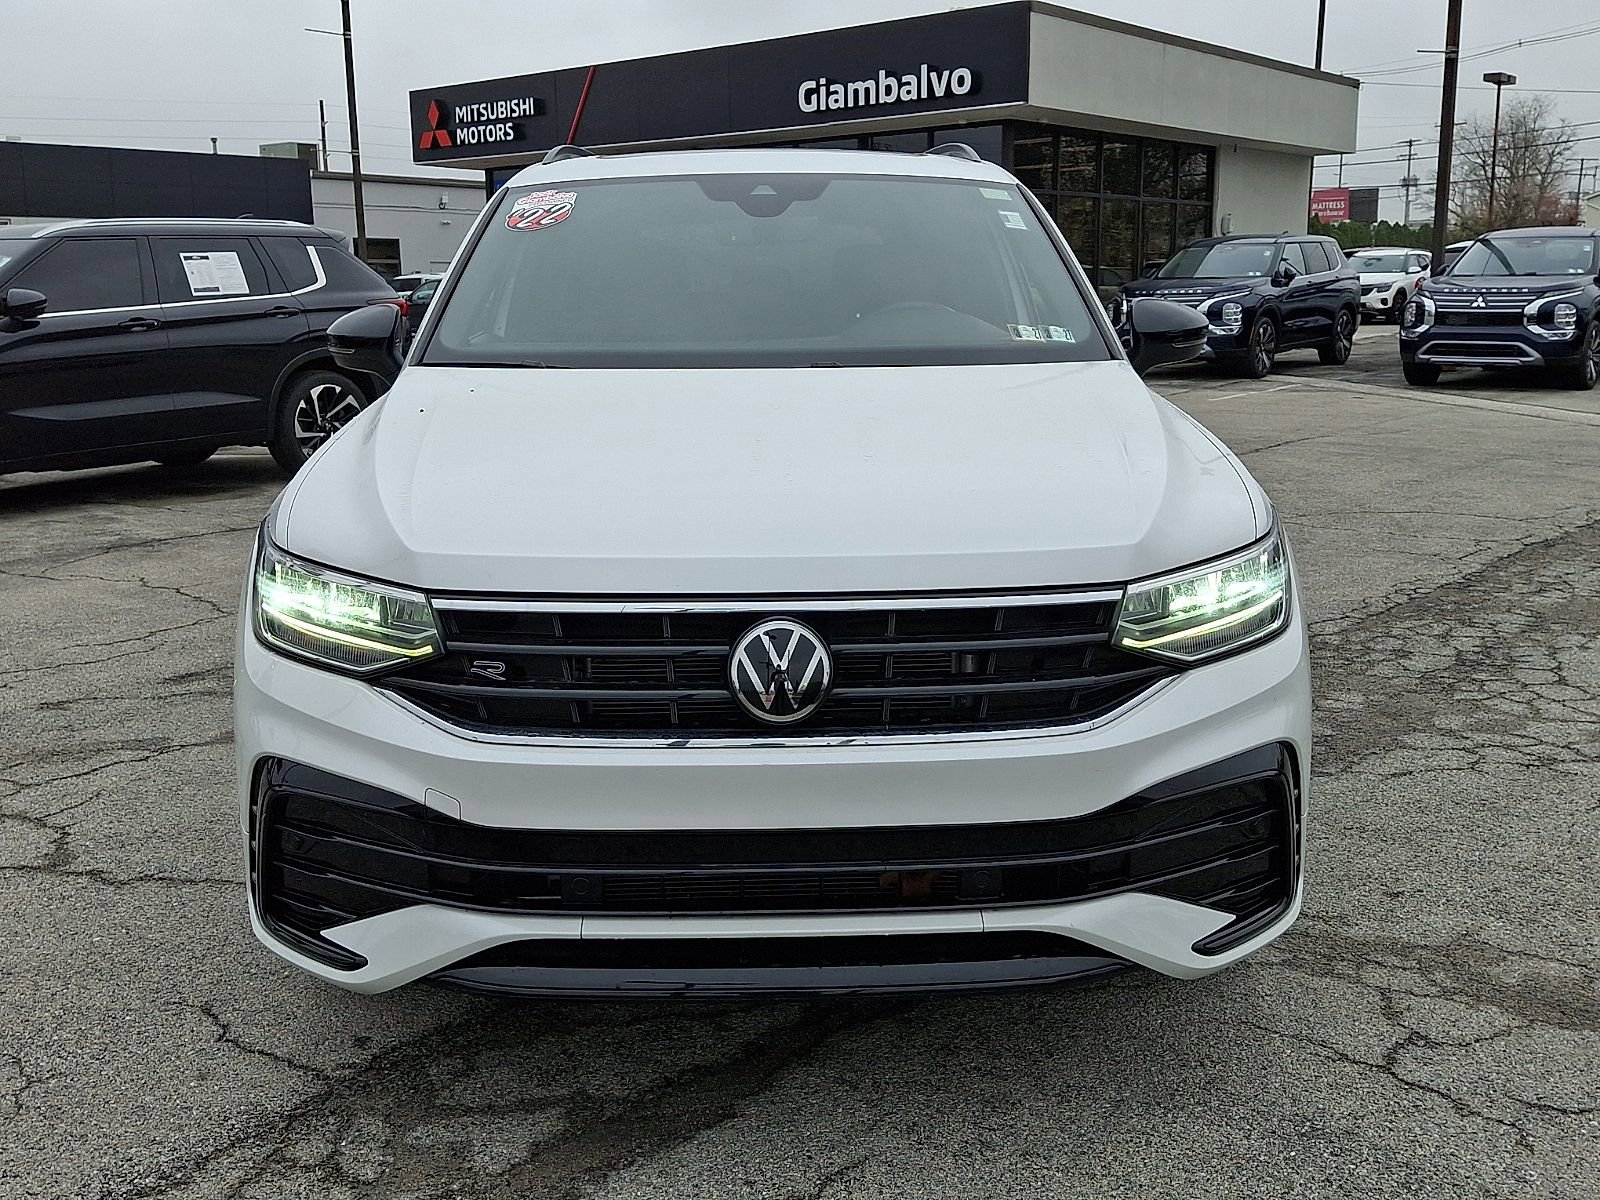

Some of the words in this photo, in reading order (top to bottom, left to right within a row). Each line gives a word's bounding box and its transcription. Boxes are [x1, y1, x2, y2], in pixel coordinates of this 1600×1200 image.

[798, 63, 972, 113] Giambalvo
[455, 96, 535, 124] MITSUBISHI
[456, 122, 514, 146] MOTORS
[1311, 200, 1345, 210] MATTRESS
